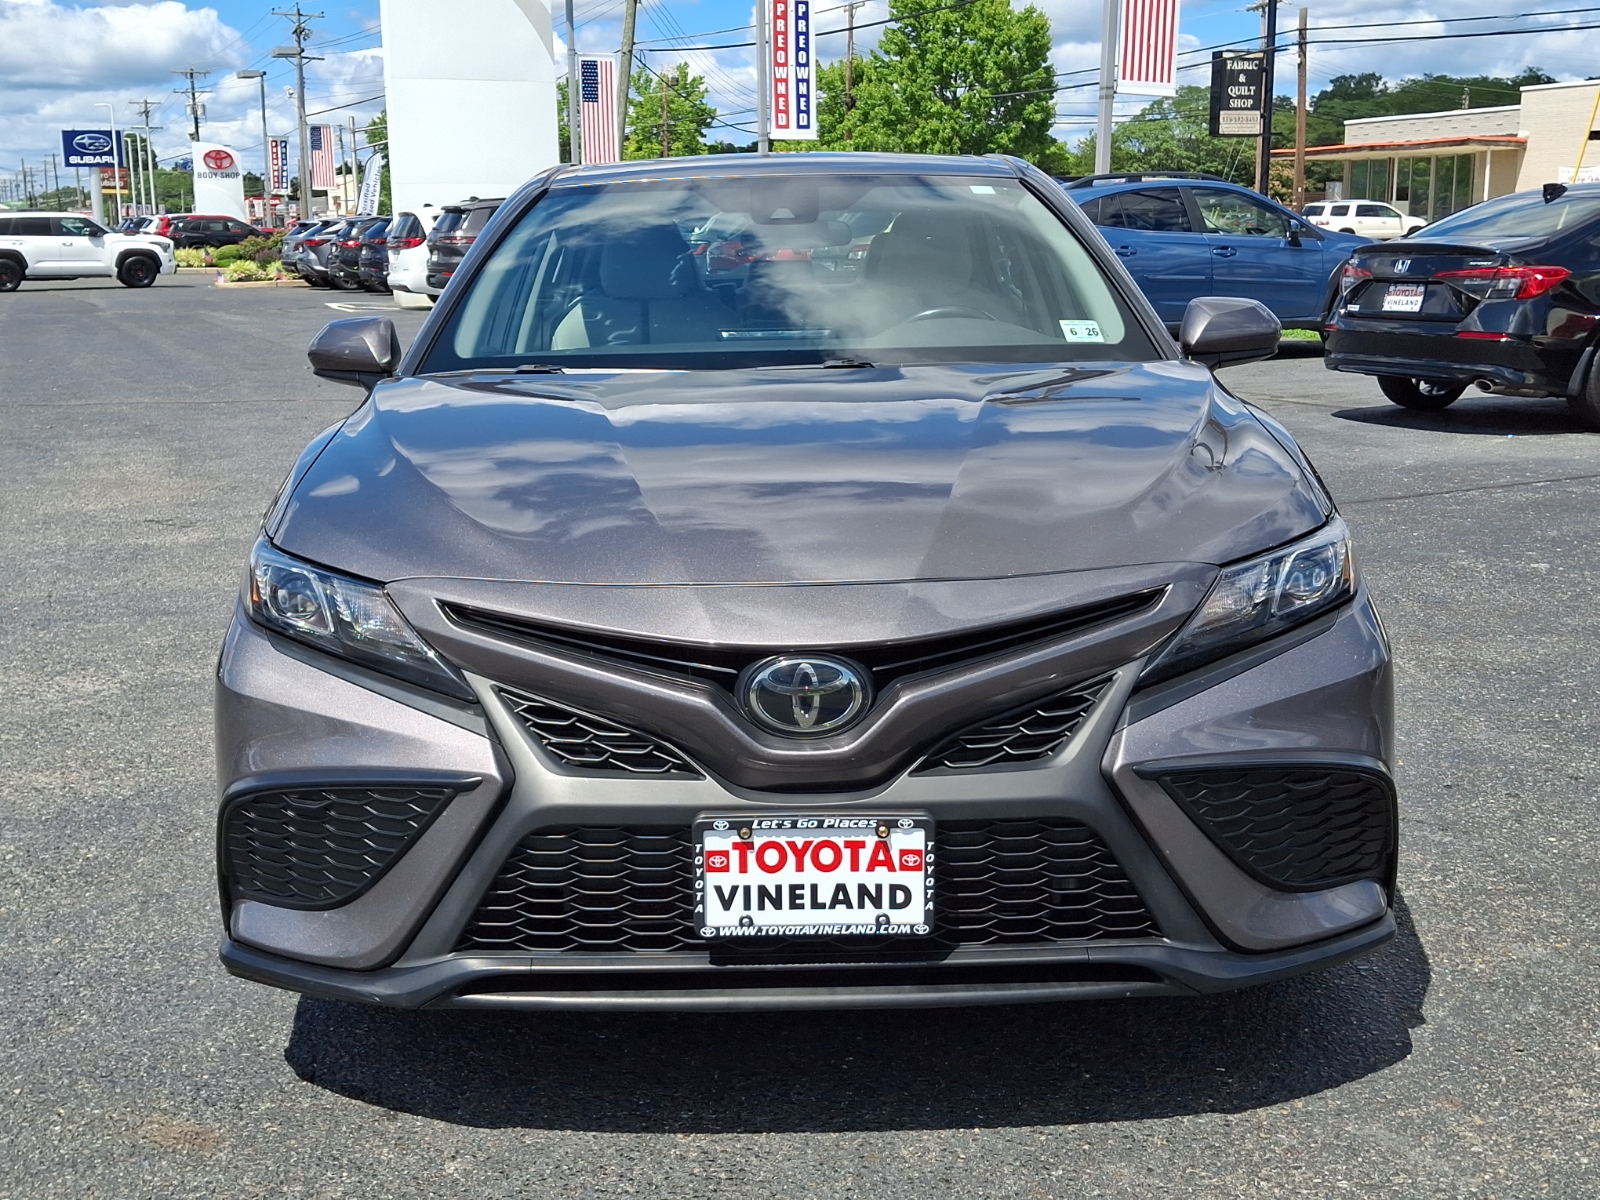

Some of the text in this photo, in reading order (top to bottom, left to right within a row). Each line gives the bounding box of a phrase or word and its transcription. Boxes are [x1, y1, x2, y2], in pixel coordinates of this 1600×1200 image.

[774, 3, 788, 126] PREOWNED
[796, 3, 809, 126] PREOWNED
[1226, 60, 1259, 70] FABRIC
[1238, 73, 1246, 83] &
[1228, 86, 1256, 97] QUILT
[1229, 99, 1253, 108] SHOP
[1393, 289, 1418, 297] TOYOTA
[1069, 327, 1099, 337] 6 26
[751, 818, 878, 829] Let's Go Places
[732, 839, 897, 874] TOYOTA
[694, 843, 704, 913] TOYOTA
[924, 841, 934, 911] TOYOTA
[713, 882, 913, 911] VINELAND
[719, 924, 911, 936] WWW.TOYOTAVINELAND.COM
